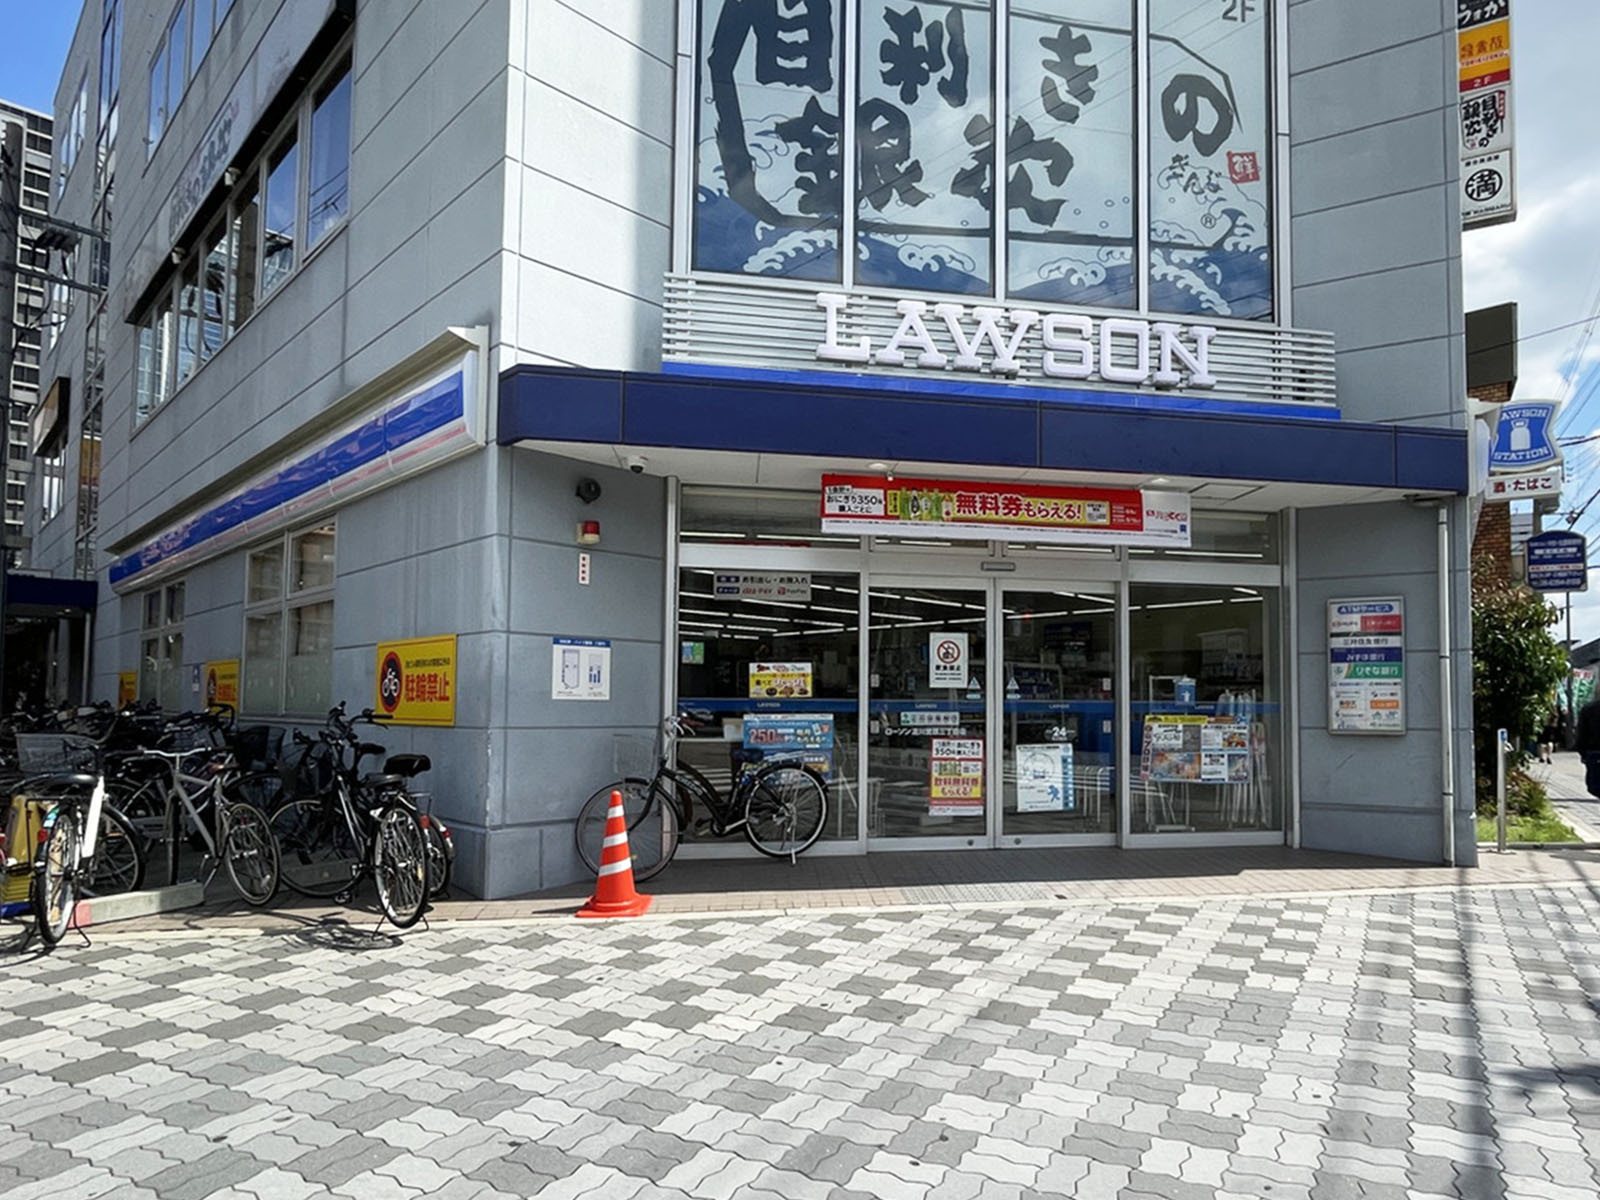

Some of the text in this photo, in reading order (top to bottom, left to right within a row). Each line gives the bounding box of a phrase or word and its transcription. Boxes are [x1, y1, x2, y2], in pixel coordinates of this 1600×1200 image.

[1473, 75, 1491, 88] 2F
[775, 95, 1074, 226] 銀次
[1467, 170, 1498, 198] 満
[816, 293, 1217, 389] LAWSON
[1501, 408, 1548, 421] AWSON
[1493, 446, 1550, 460] STATION
[1052, 726, 1067, 737] 24
